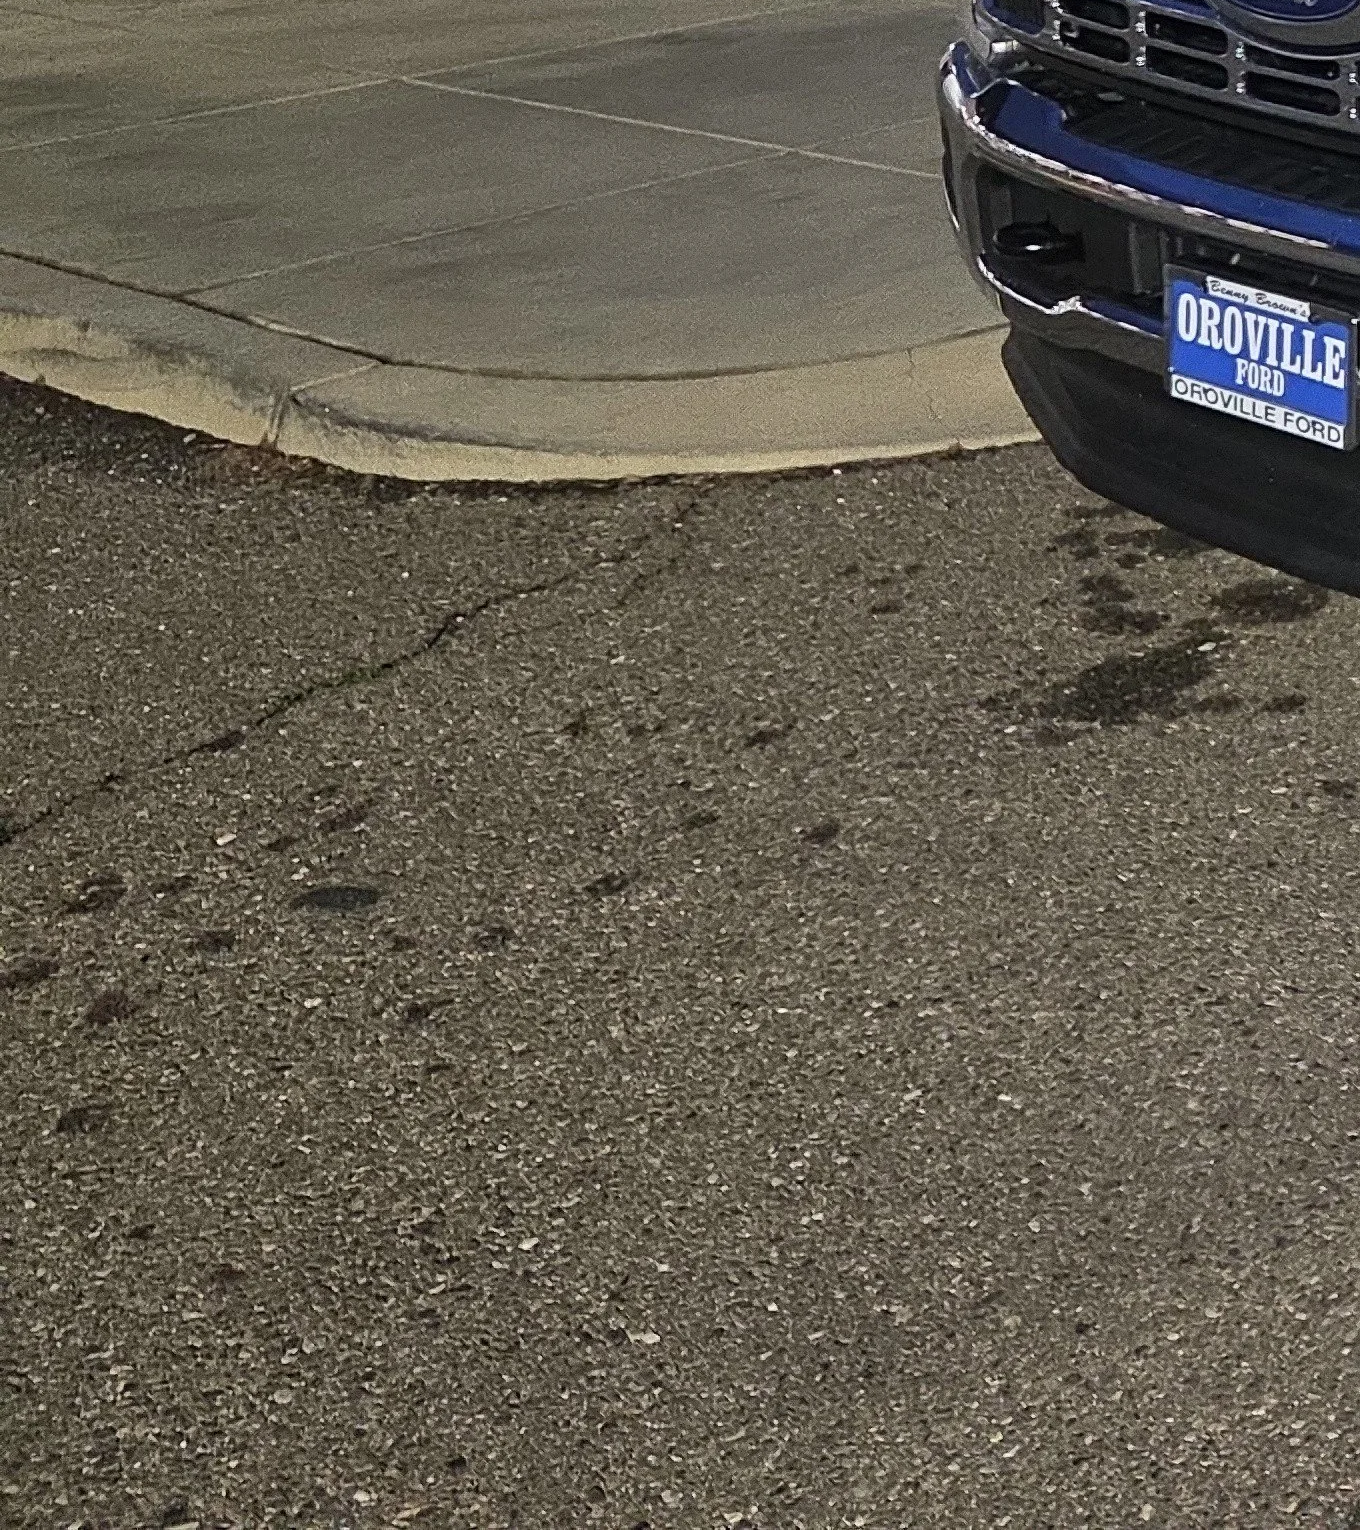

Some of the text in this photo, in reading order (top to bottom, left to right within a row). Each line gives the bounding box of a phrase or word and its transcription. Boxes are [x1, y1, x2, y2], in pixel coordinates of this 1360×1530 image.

[1210, 280, 1308, 318] Benny Brown's
[1178, 293, 1346, 389] OROVILLE
[1235, 358, 1285, 397] FORD
[1174, 378, 1341, 443] OROVILLE FORD
